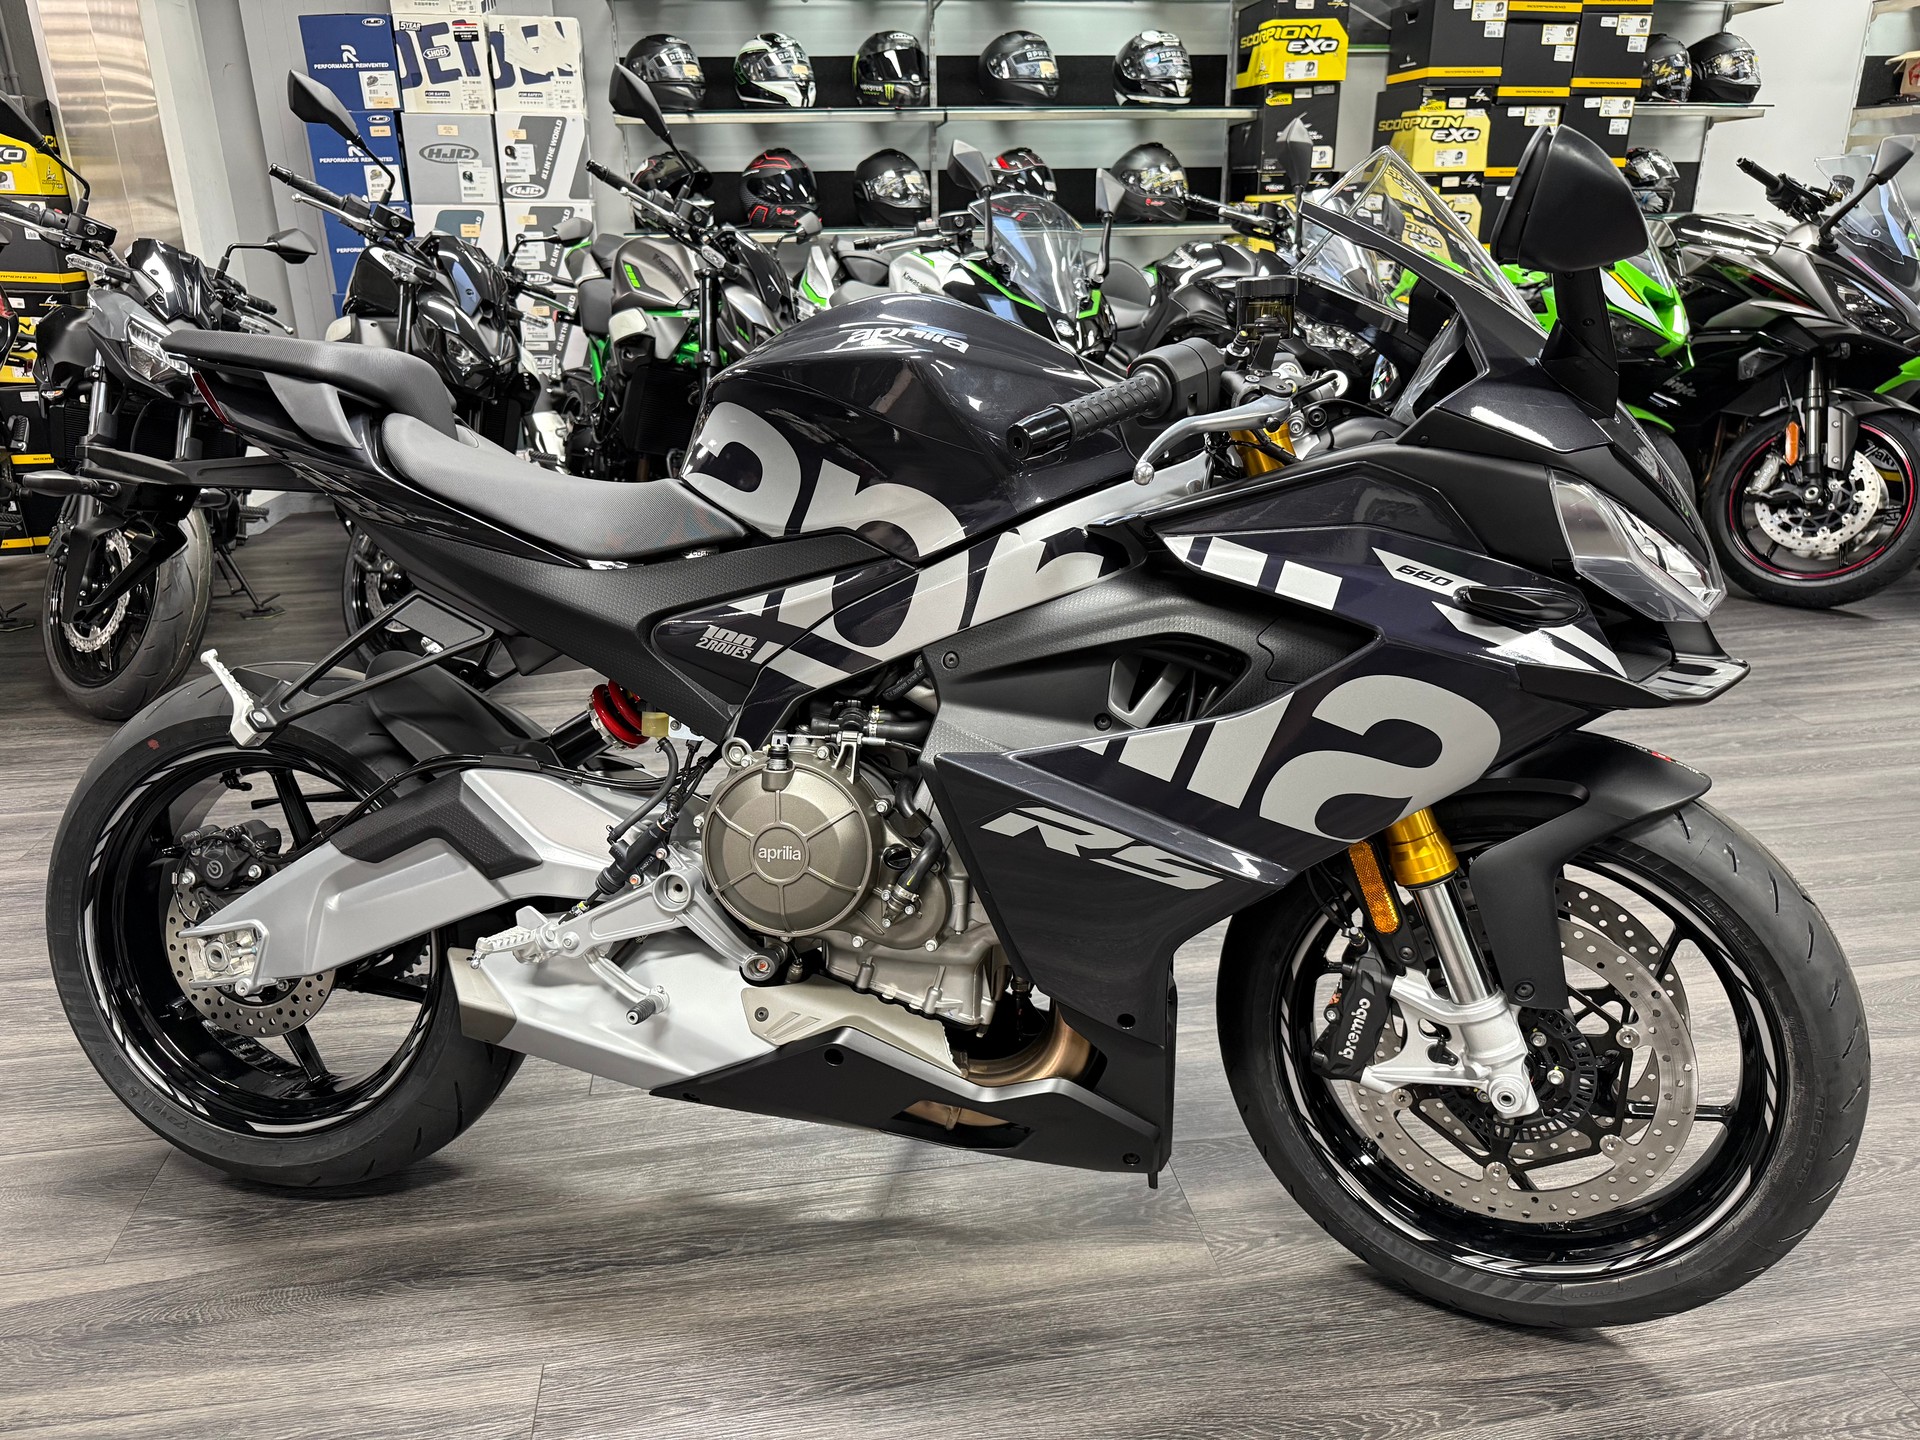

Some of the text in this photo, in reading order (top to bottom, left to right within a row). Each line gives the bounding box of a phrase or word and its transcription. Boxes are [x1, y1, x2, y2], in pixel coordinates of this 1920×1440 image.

[1240, 26, 1320, 48] SCORPION
[1287, 38, 1339, 54] EXO
[1378, 116, 1463, 131] SCORPION
[1431, 127, 1481, 142] EXO
[427, 148, 471, 158] HJC
[511, 186, 541, 195] HJC
[846, 327, 970, 354] aprilia
[1396, 565, 1454, 587] 660
[758, 846, 802, 862] aprilia
[980, 807, 1224, 890] RS
[1338, 998, 1371, 1060] brembo
